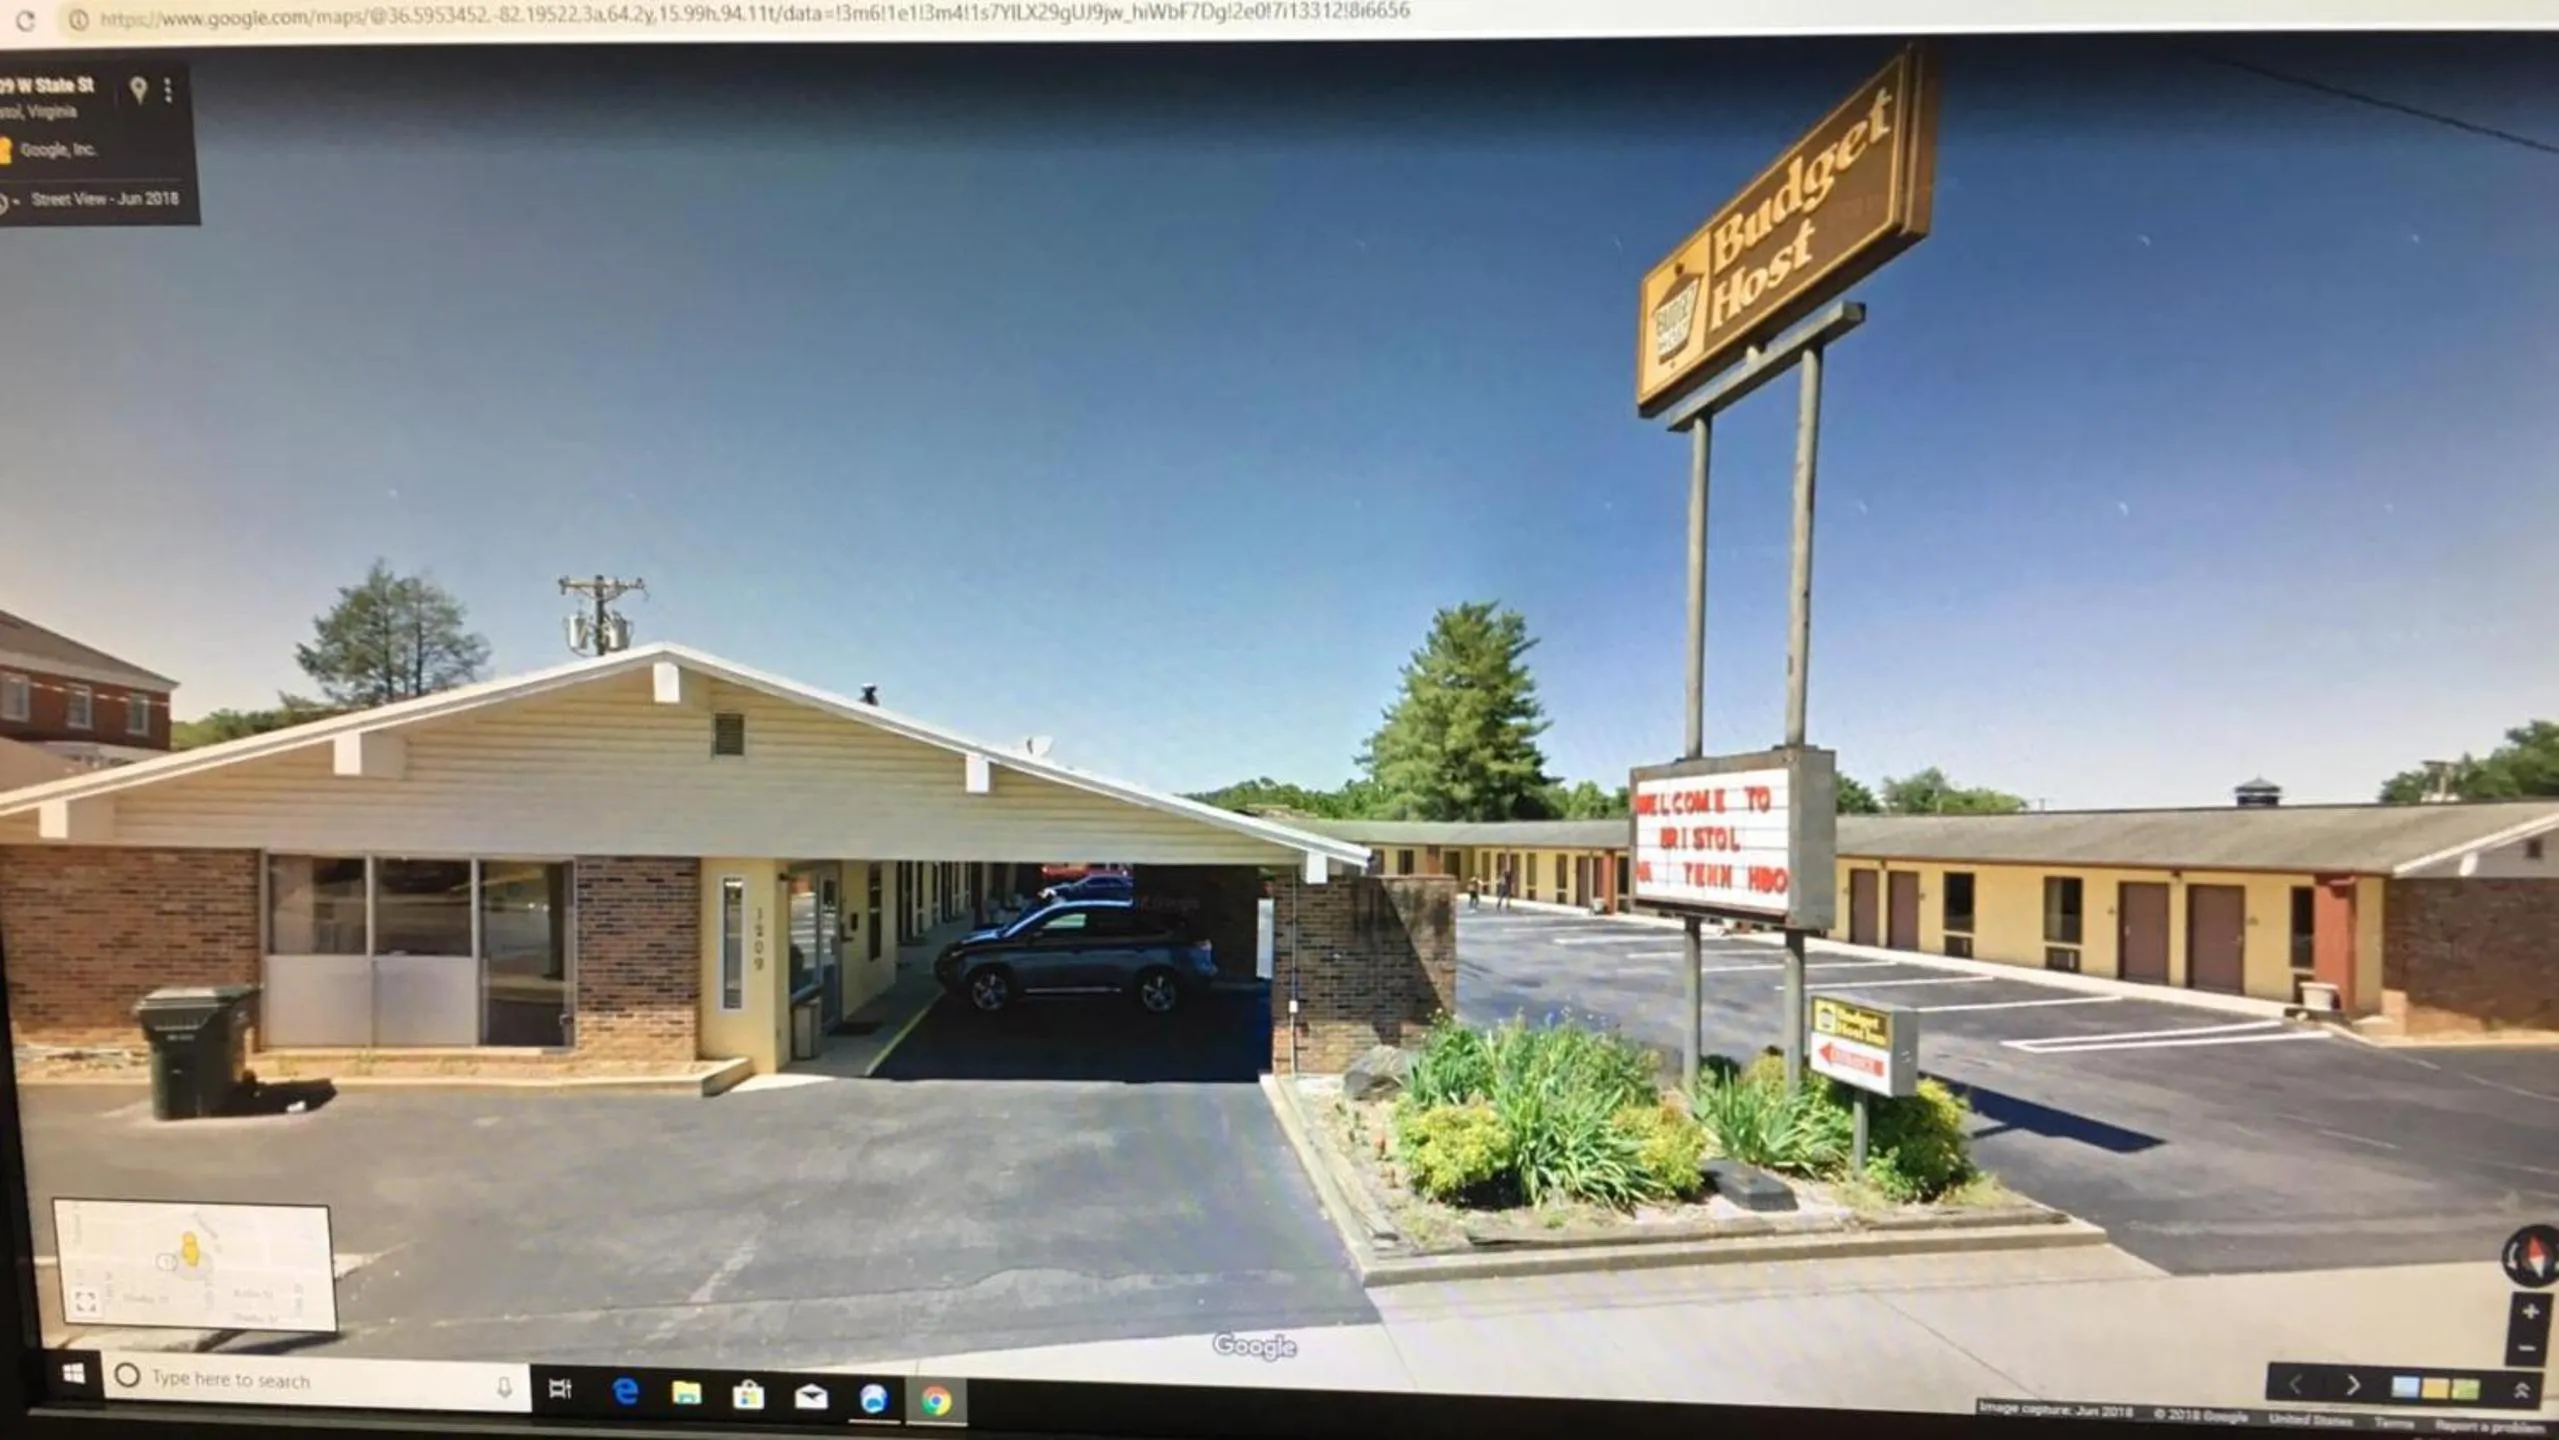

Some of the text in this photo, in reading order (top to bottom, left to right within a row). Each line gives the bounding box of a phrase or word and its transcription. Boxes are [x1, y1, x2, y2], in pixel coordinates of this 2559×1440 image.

[17, 78, 32, 93] W
[36, 78, 75, 93] State
[78, 76, 94, 93] St
[28, 103, 78, 122] Virginia
[1712, 86, 1892, 275] Budget
[32, 191, 71, 206] Street
[73, 191, 107, 206] View
[117, 192, 142, 206] Jun
[145, 190, 180, 206] 2018
[1710, 217, 1815, 332] Host
[1635, 786, 1771, 815] WELCOME TO
[1659, 826, 1741, 852] BRISTOL
[1212, 1331, 1298, 1362] Google
[153, 1369, 311, 1390] Type here to search
[1979, 1401, 2019, 1416] Image
[2076, 1405, 2099, 1418] Jun
[2102, 1406, 2134, 1419] 2018
[2168, 1408, 2200, 1421] 2018
[2203, 1409, 2249, 1425] Google
[2268, 1412, 2355, 1428] United States
[2374, 1416, 2415, 1430] Terms
[2435, 1418, 2478, 1433] Report
[2491, 1420, 2547, 1435] problem
